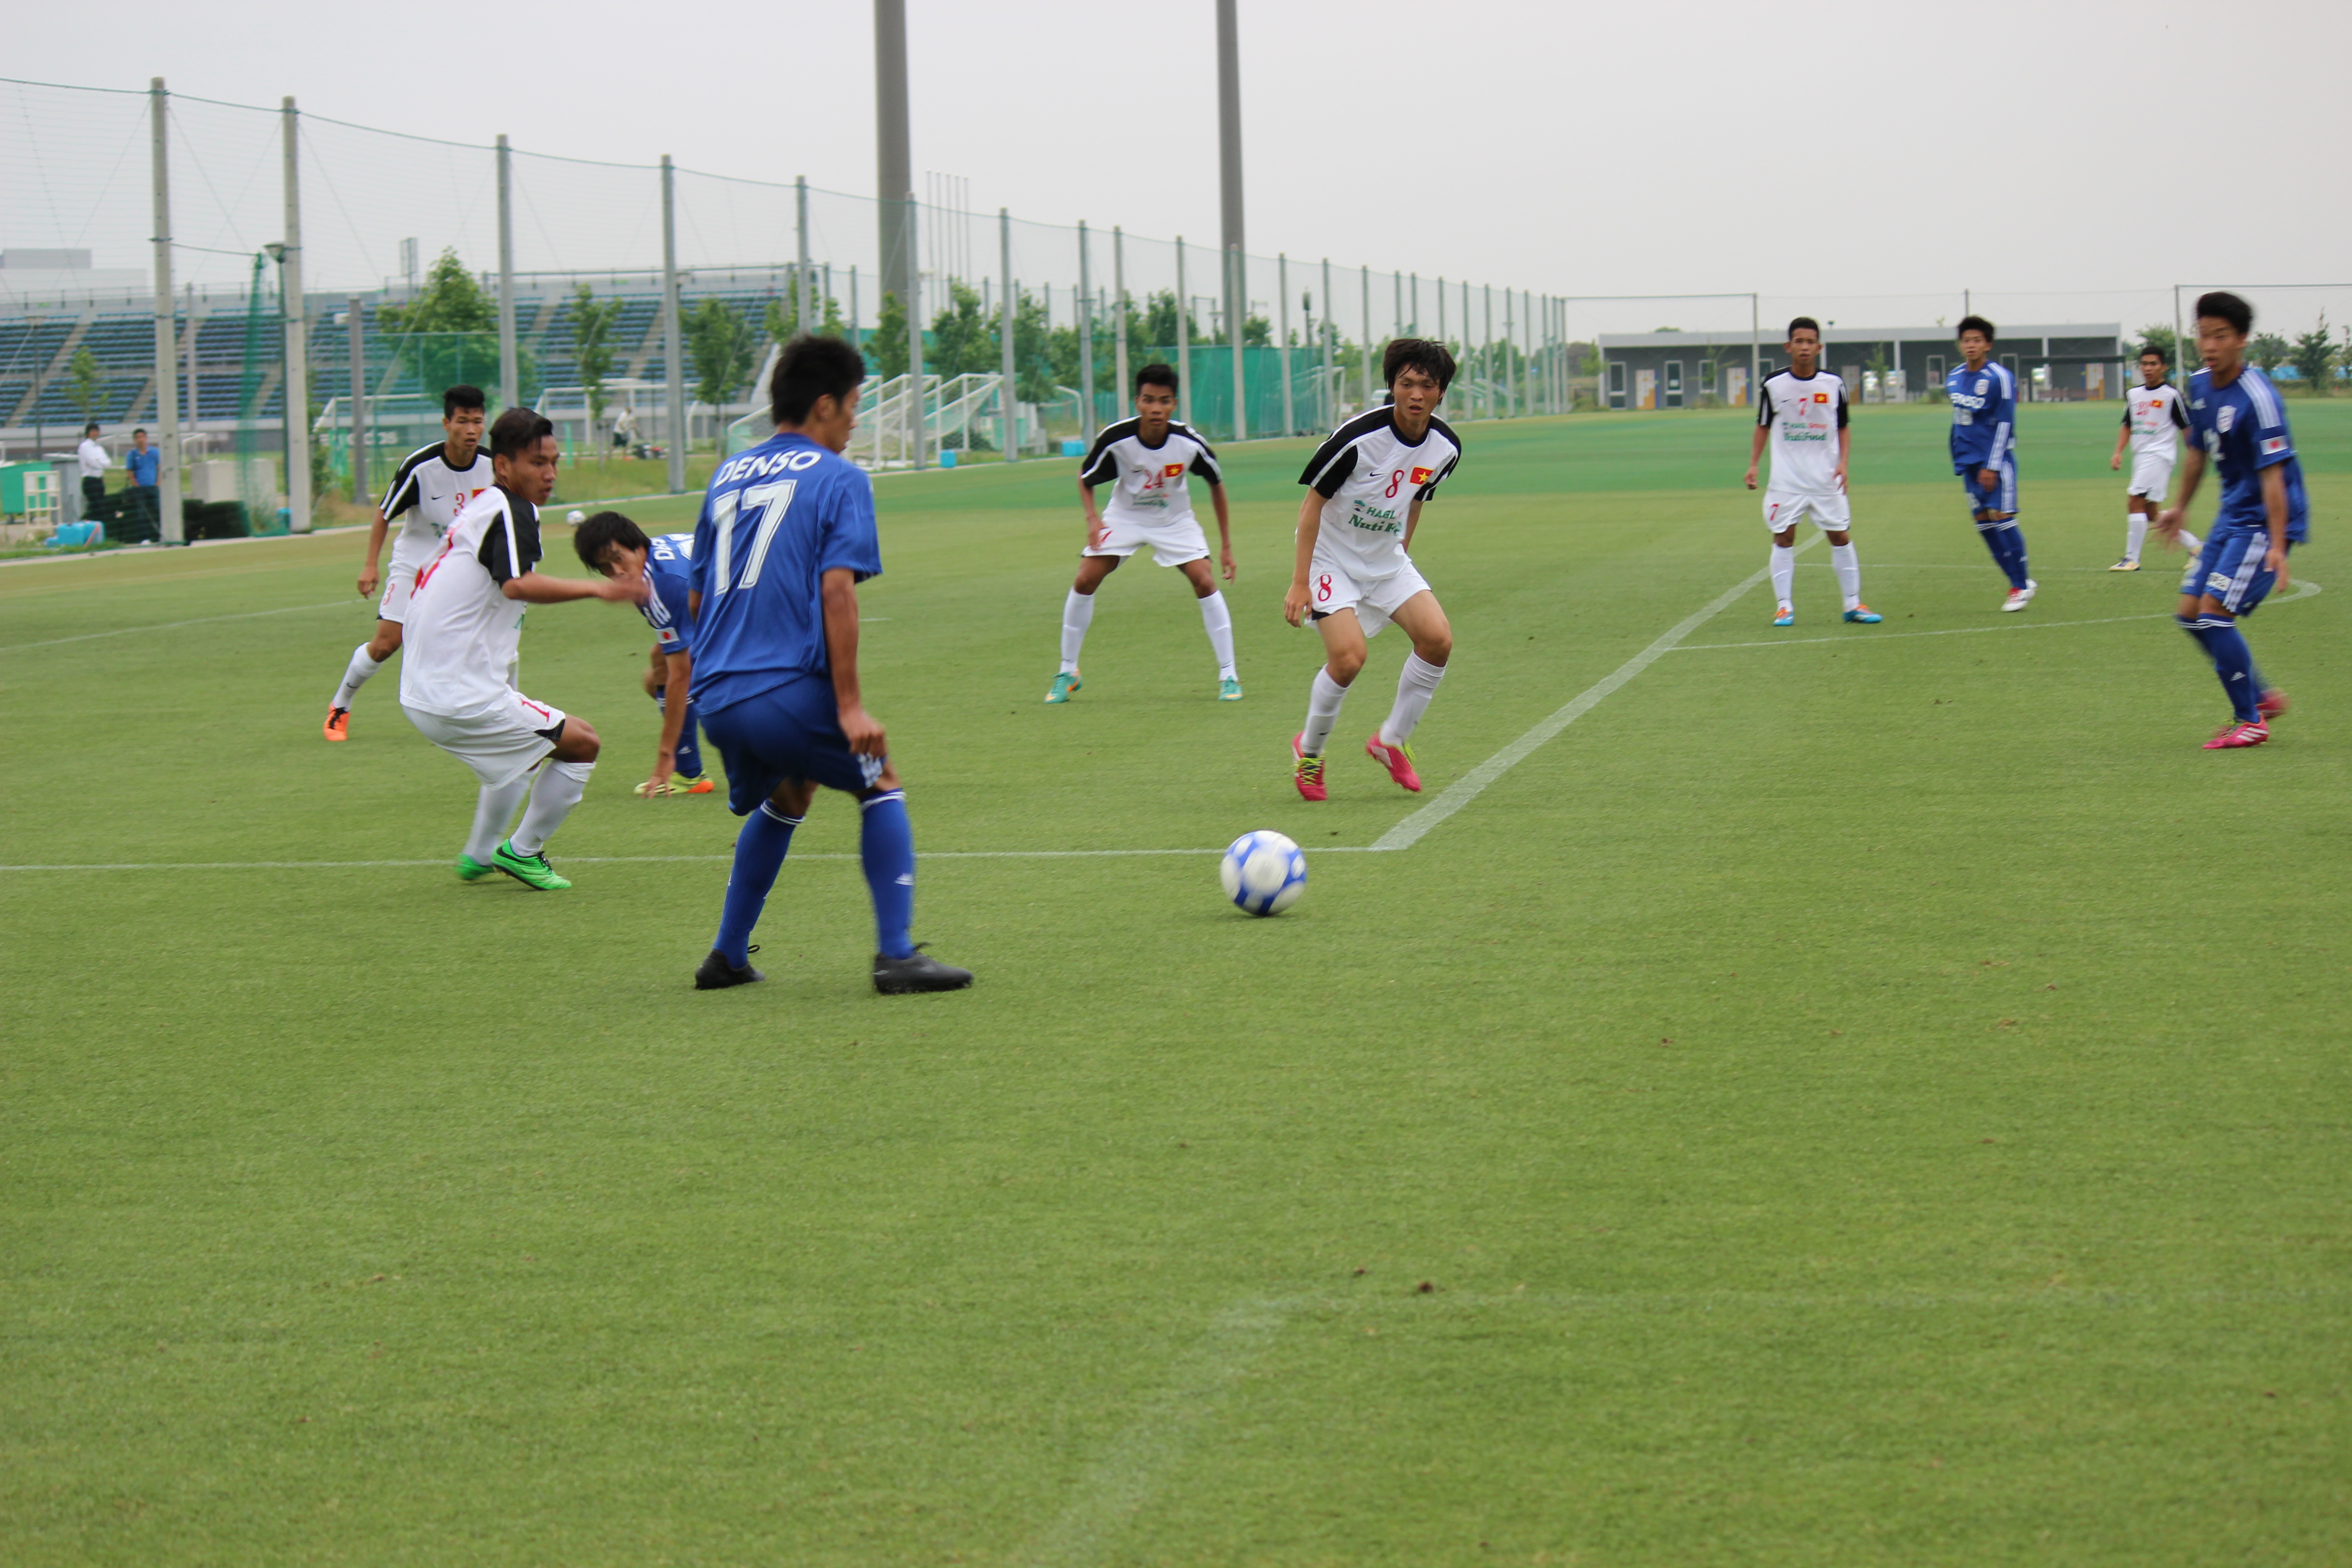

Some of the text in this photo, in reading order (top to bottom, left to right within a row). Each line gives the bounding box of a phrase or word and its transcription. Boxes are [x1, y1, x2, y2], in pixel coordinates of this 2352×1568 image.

[1798, 397, 1808, 416] 7
[712, 451, 822, 490] DENSO
[1144, 470, 1165, 489] 24
[1385, 469, 1405, 498] 8
[453, 492, 465, 516] 3
[1366, 507, 1396, 519] HAGL
[1769, 503, 1780, 521] 7
[712, 479, 798, 597] 17
[382, 583, 396, 606] 3
[1318, 573, 1332, 602] 8
